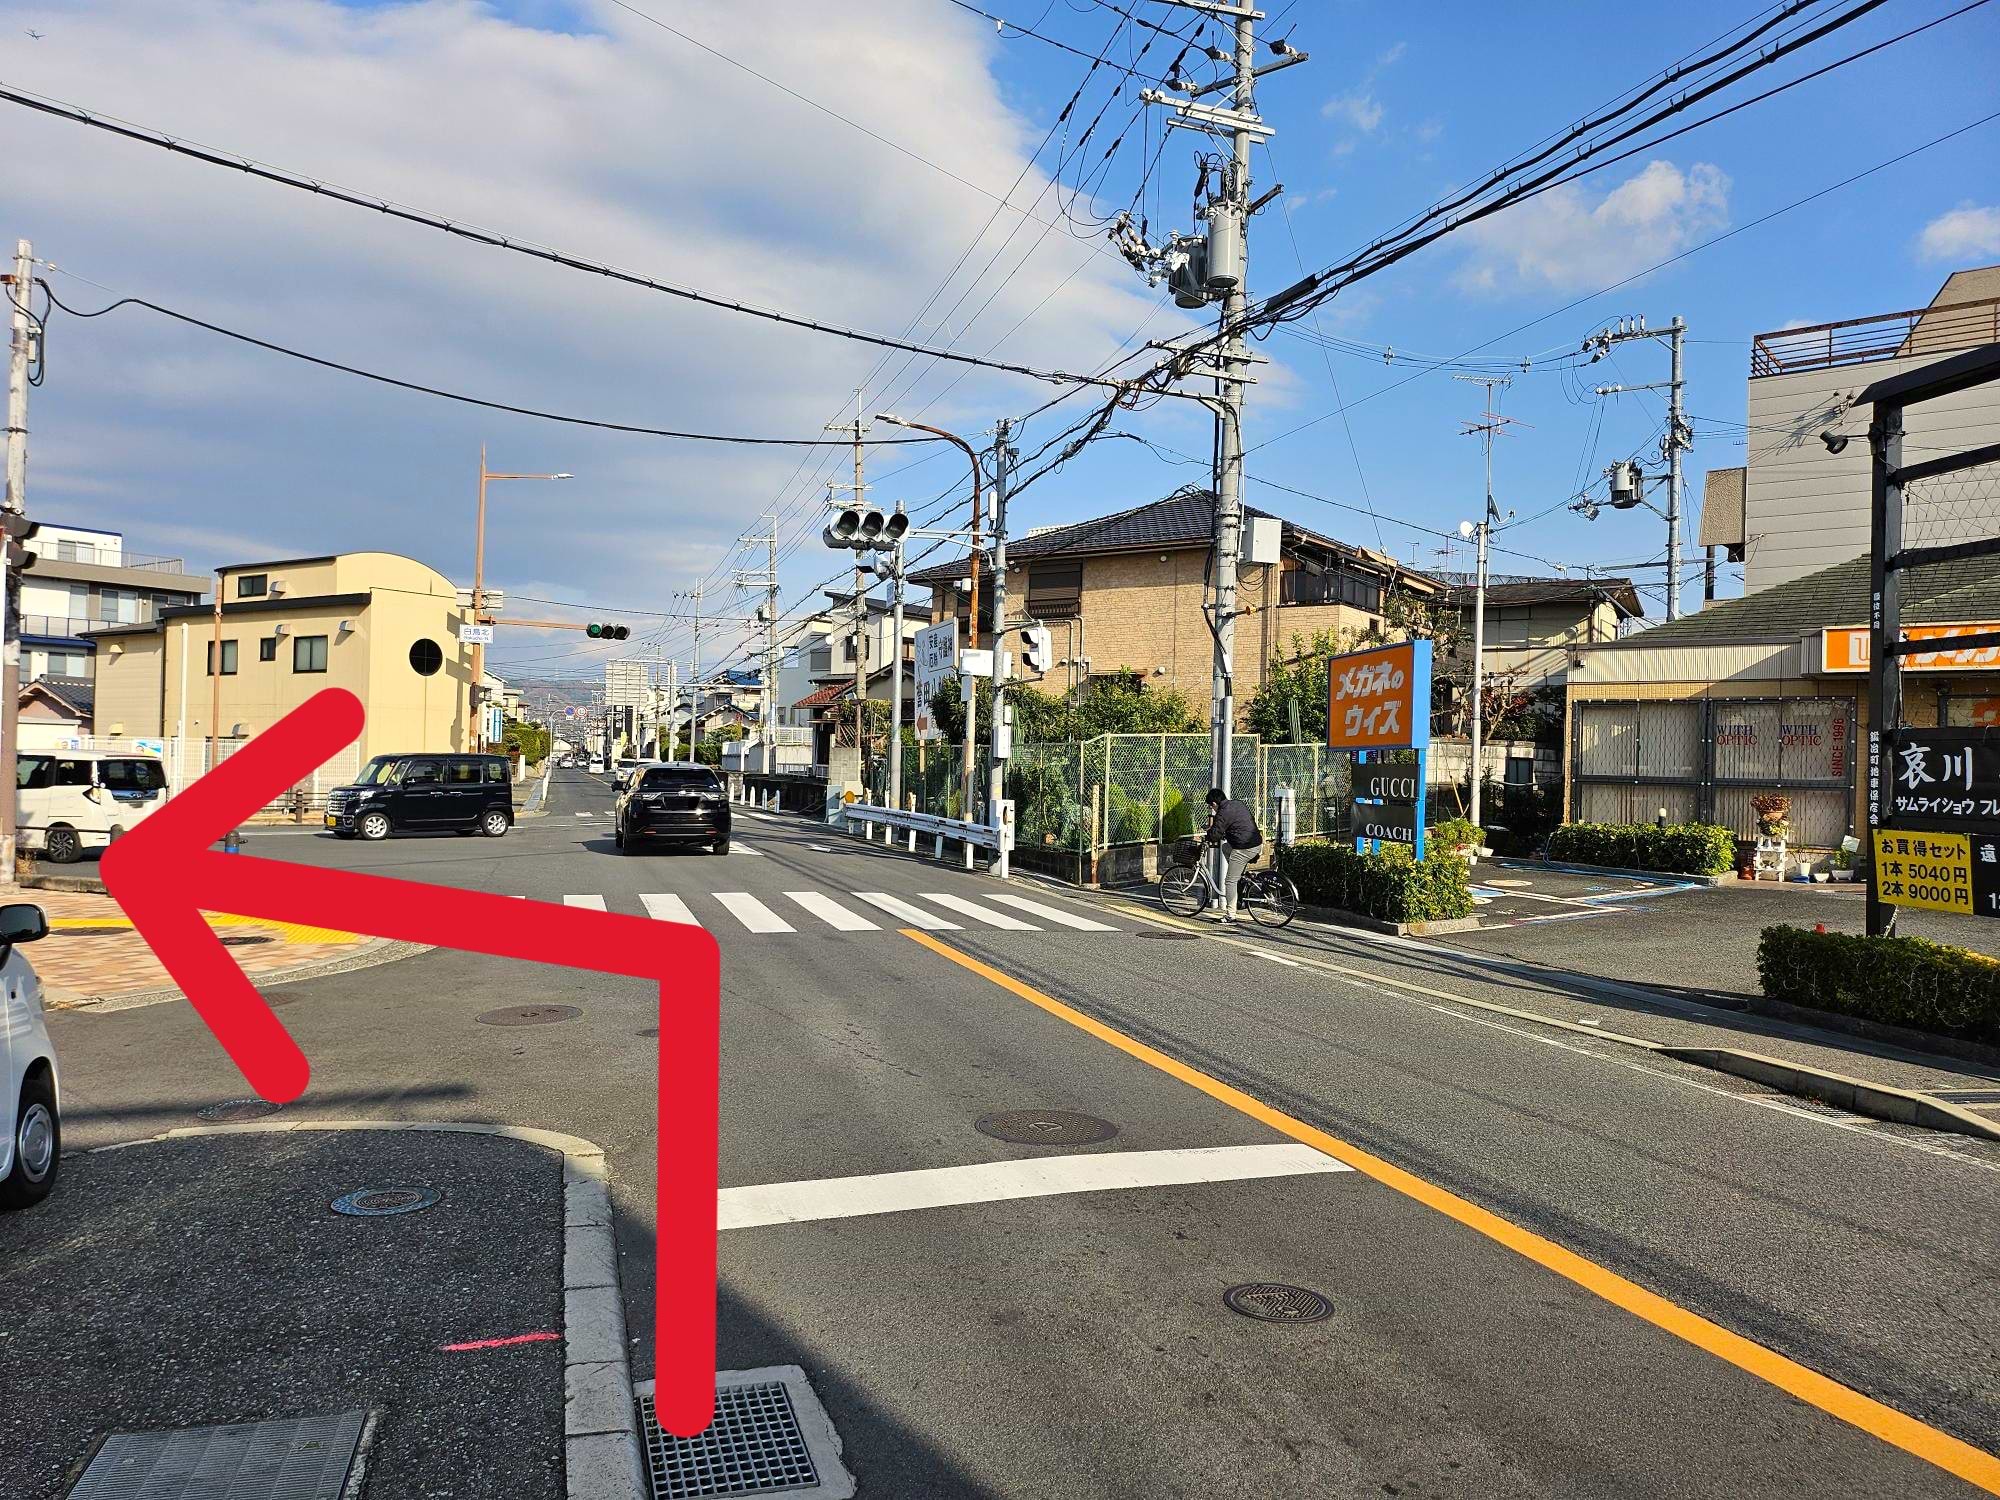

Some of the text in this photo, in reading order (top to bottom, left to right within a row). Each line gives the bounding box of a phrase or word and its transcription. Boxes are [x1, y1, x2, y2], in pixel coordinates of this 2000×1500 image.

[1336, 660, 1404, 700] メガネの
[1717, 724, 1753, 735] WITH
[1781, 724, 1817, 735] WITH
[1717, 735, 1758, 745] OPTIC
[1781, 735, 1822, 746] OPTIC
[1832, 745, 1843, 777] SINCE
[1899, 742, 1973, 791] 哀川
[1370, 777, 1416, 799] GUCCI
[1896, 796, 1975, 815] サムライショウ
[1366, 823, 1413, 842] COACH
[1881, 838, 1966, 860] お買得セット
[1881, 861, 1903, 877] 1本
[1882, 880, 1904, 897] 2本
